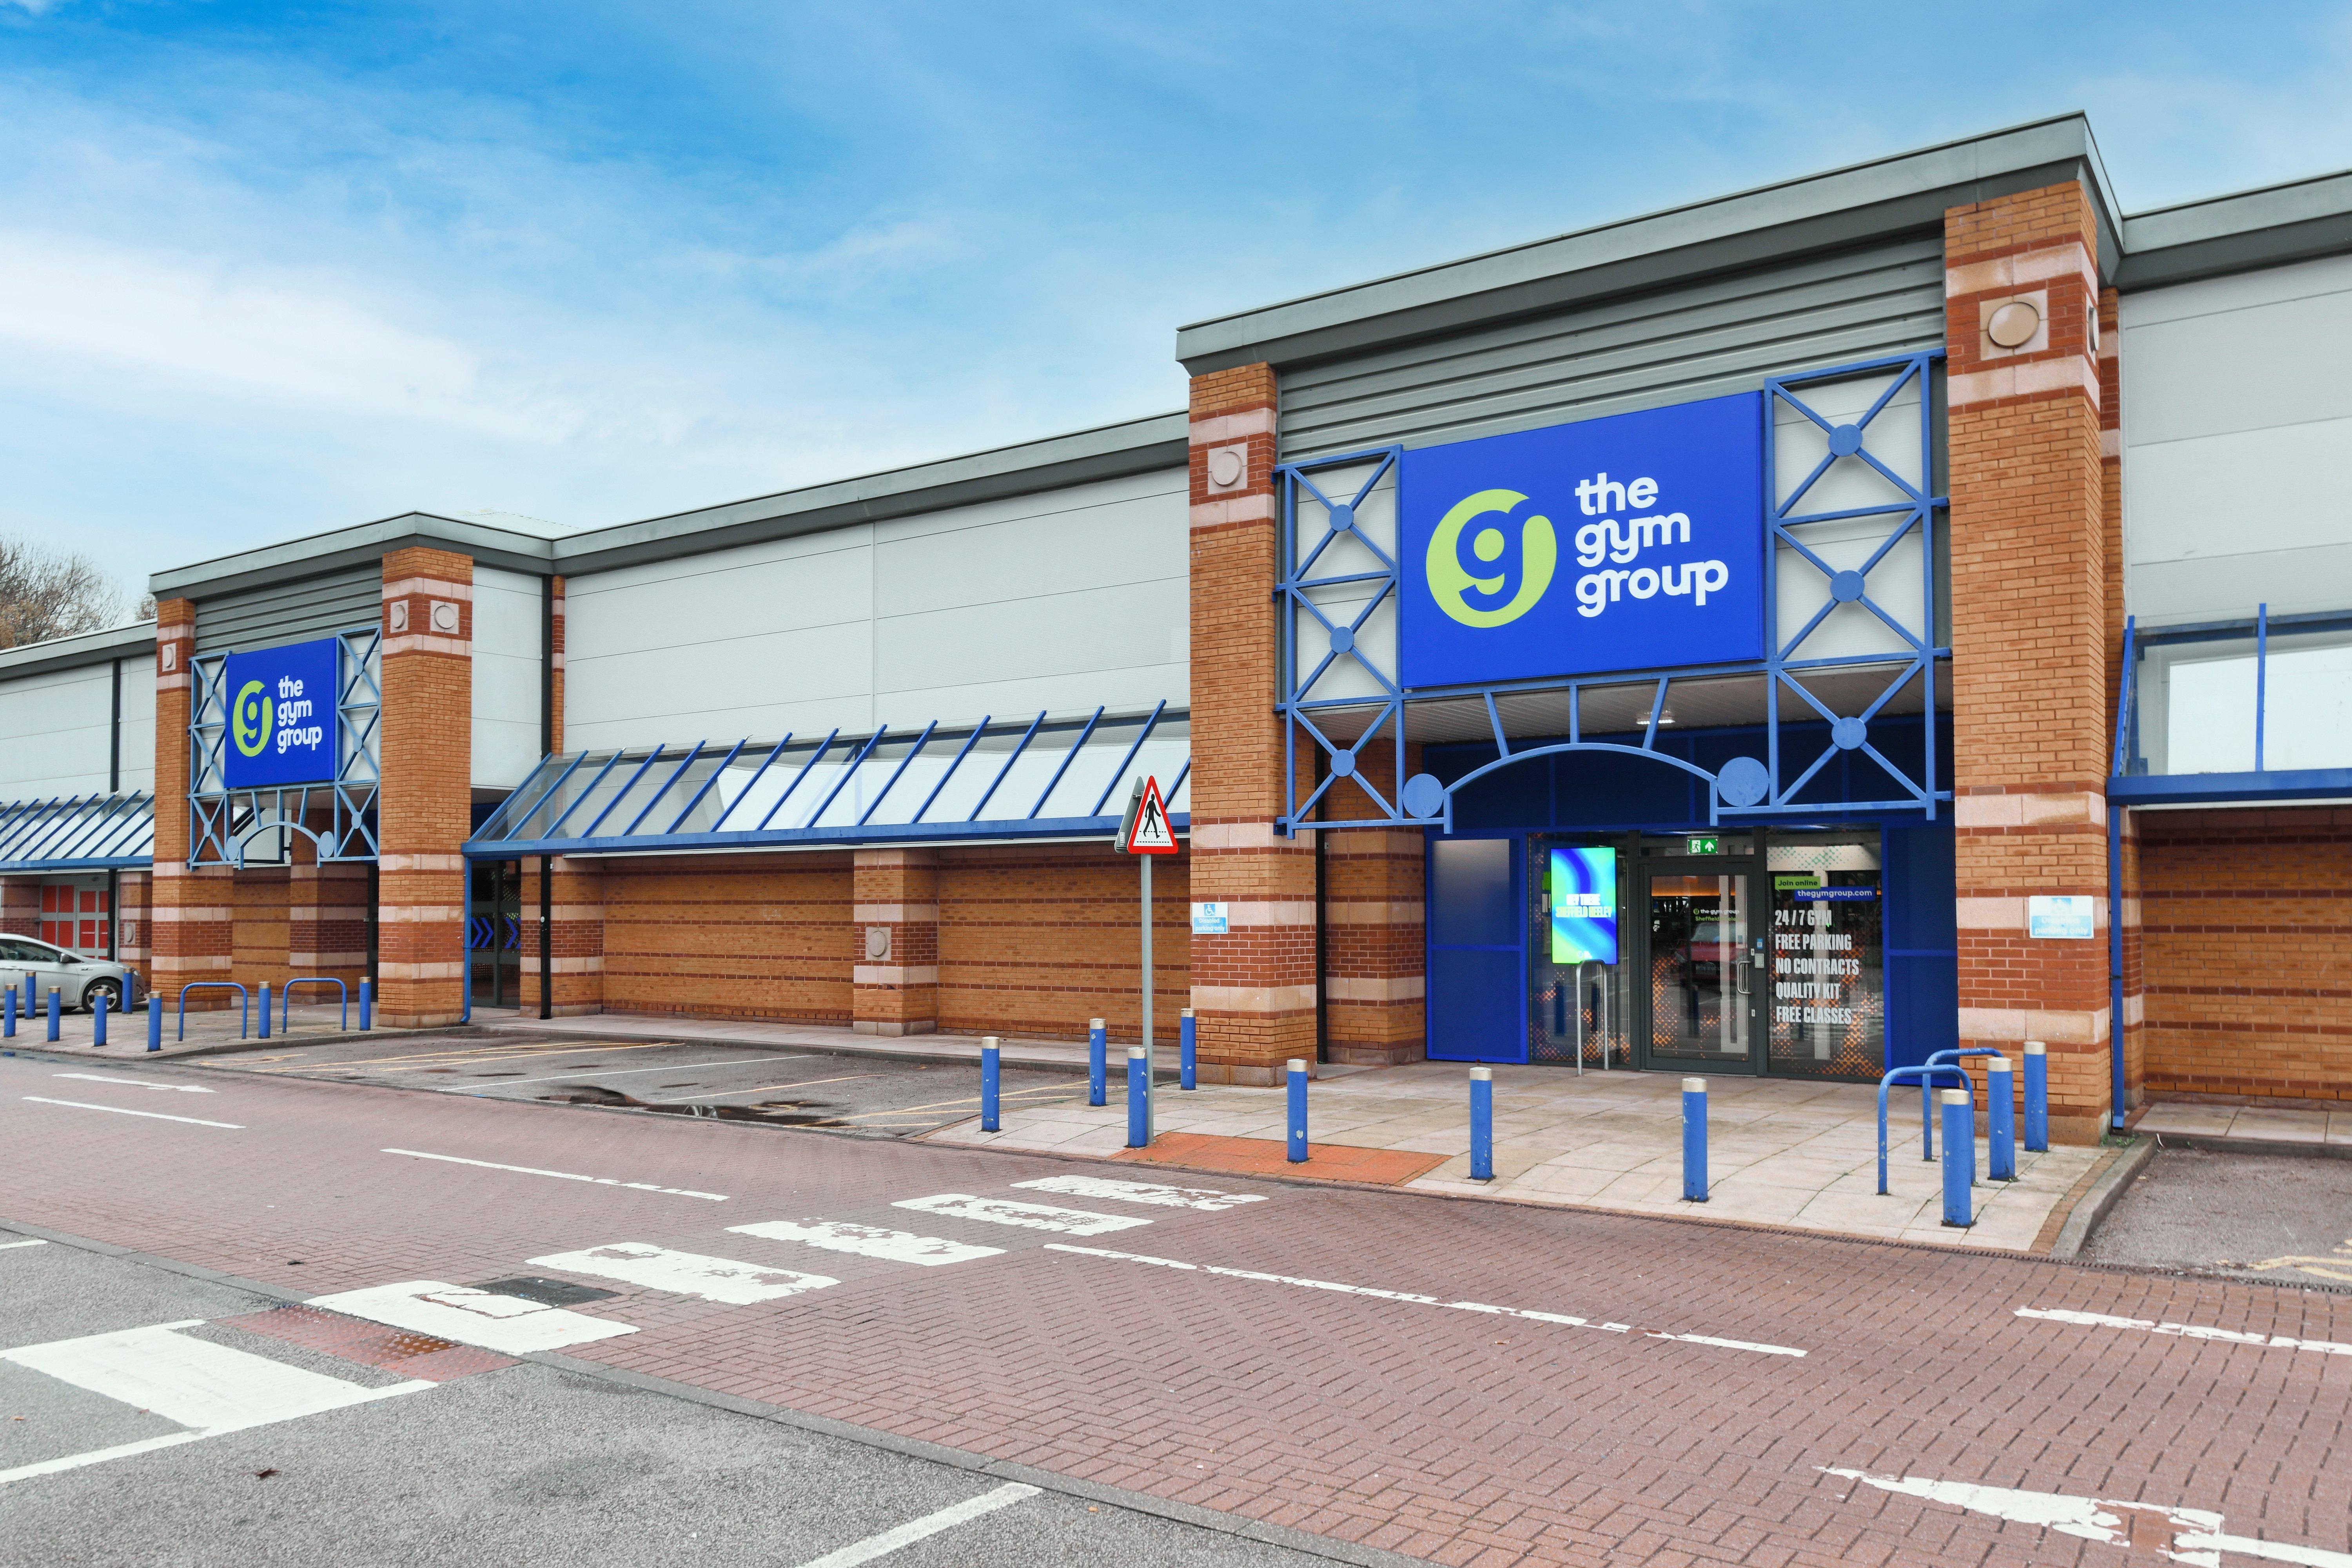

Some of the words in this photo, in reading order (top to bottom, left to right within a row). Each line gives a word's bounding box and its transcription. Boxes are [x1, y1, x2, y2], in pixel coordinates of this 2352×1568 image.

[1575, 472, 1659, 515] the
[1575, 512, 1690, 567] gym
[1575, 560, 1729, 618] group
[278, 675, 303, 699] the
[278, 700, 312, 727] gym
[277, 726, 322, 754] group
[1797, 890, 1872, 898] thegymgroup.com
[1808, 910, 1832, 926] GYM
[1775, 934, 1800, 950] FREE
[1802, 934, 1852, 951] PARKING
[1776, 957, 1791, 974] NO
[1793, 958, 1859, 976] CONTRACTS
[1776, 981, 1822, 1000] QUALITY
[1822, 982, 1841, 1000] KIT
[1776, 1006, 1802, 1023] FREE
[1804, 1006, 1852, 1025] CLASSES
